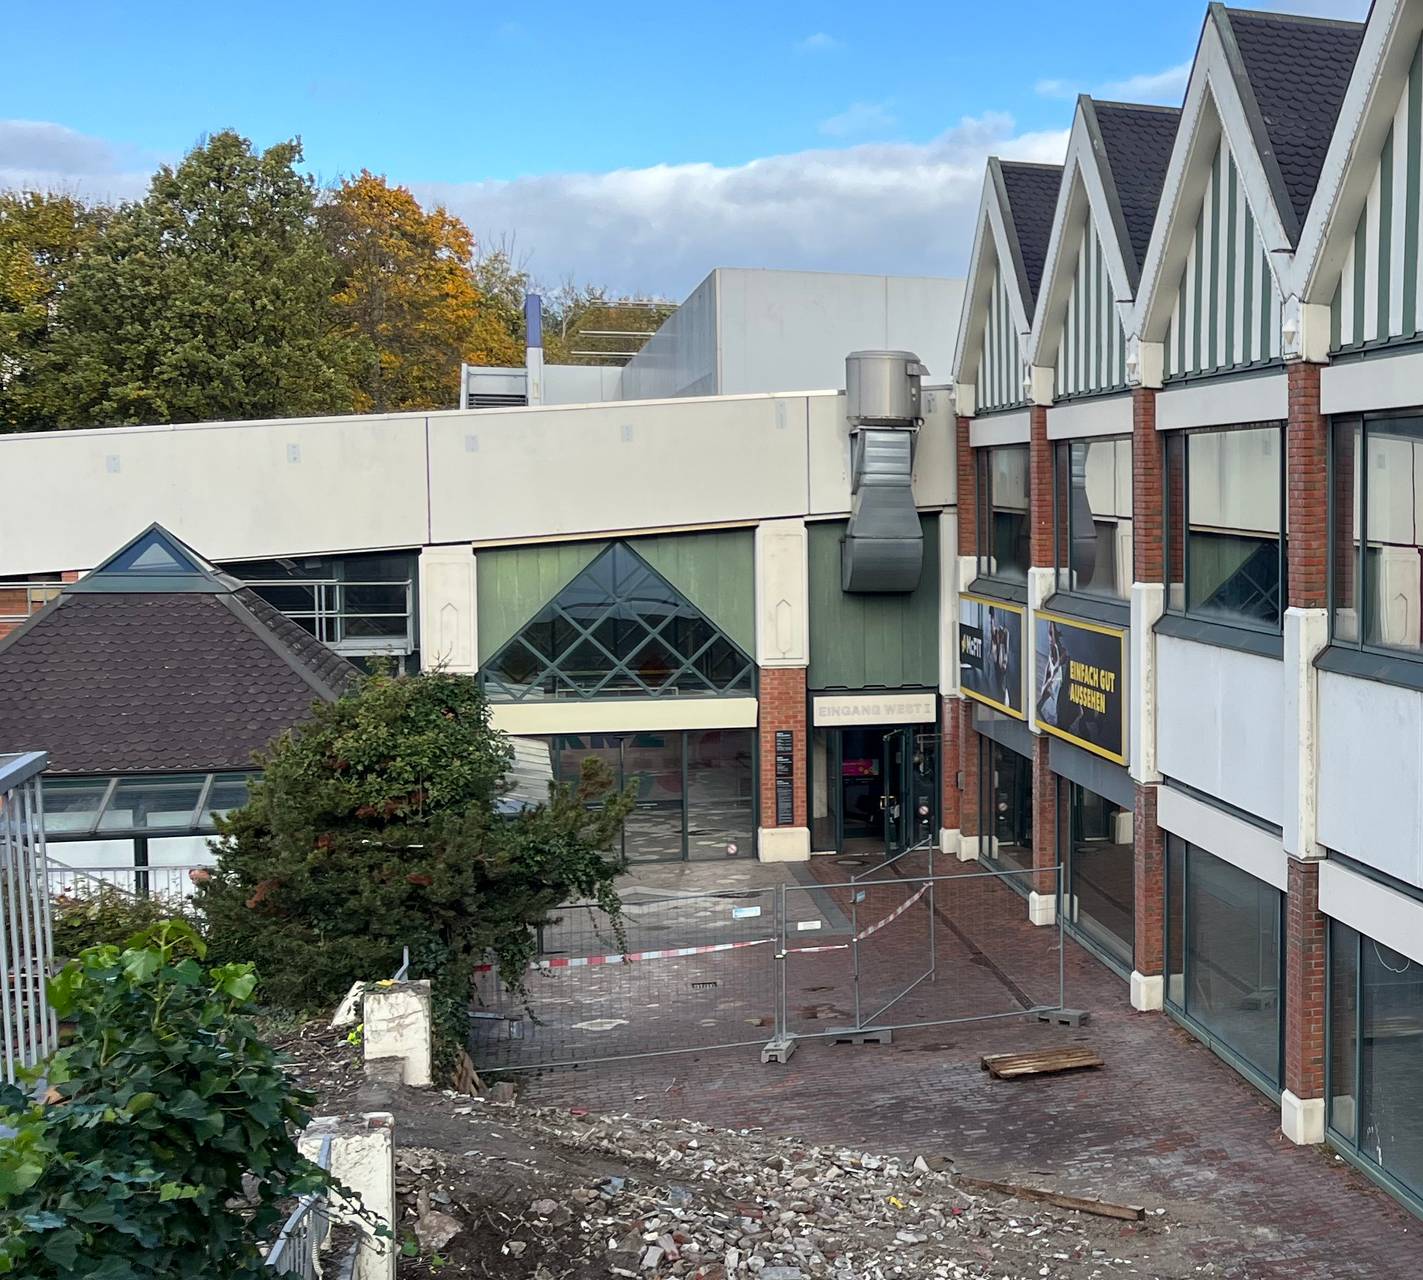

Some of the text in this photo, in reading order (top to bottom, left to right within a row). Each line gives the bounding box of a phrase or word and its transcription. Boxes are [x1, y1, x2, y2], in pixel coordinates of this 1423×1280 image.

[1070, 661, 1115, 693] EINFACH GUT
[818, 705, 880, 717] EINGANG
[884, 704, 921, 715] WEST
[1070, 684, 1105, 714] AUSSEHEN
